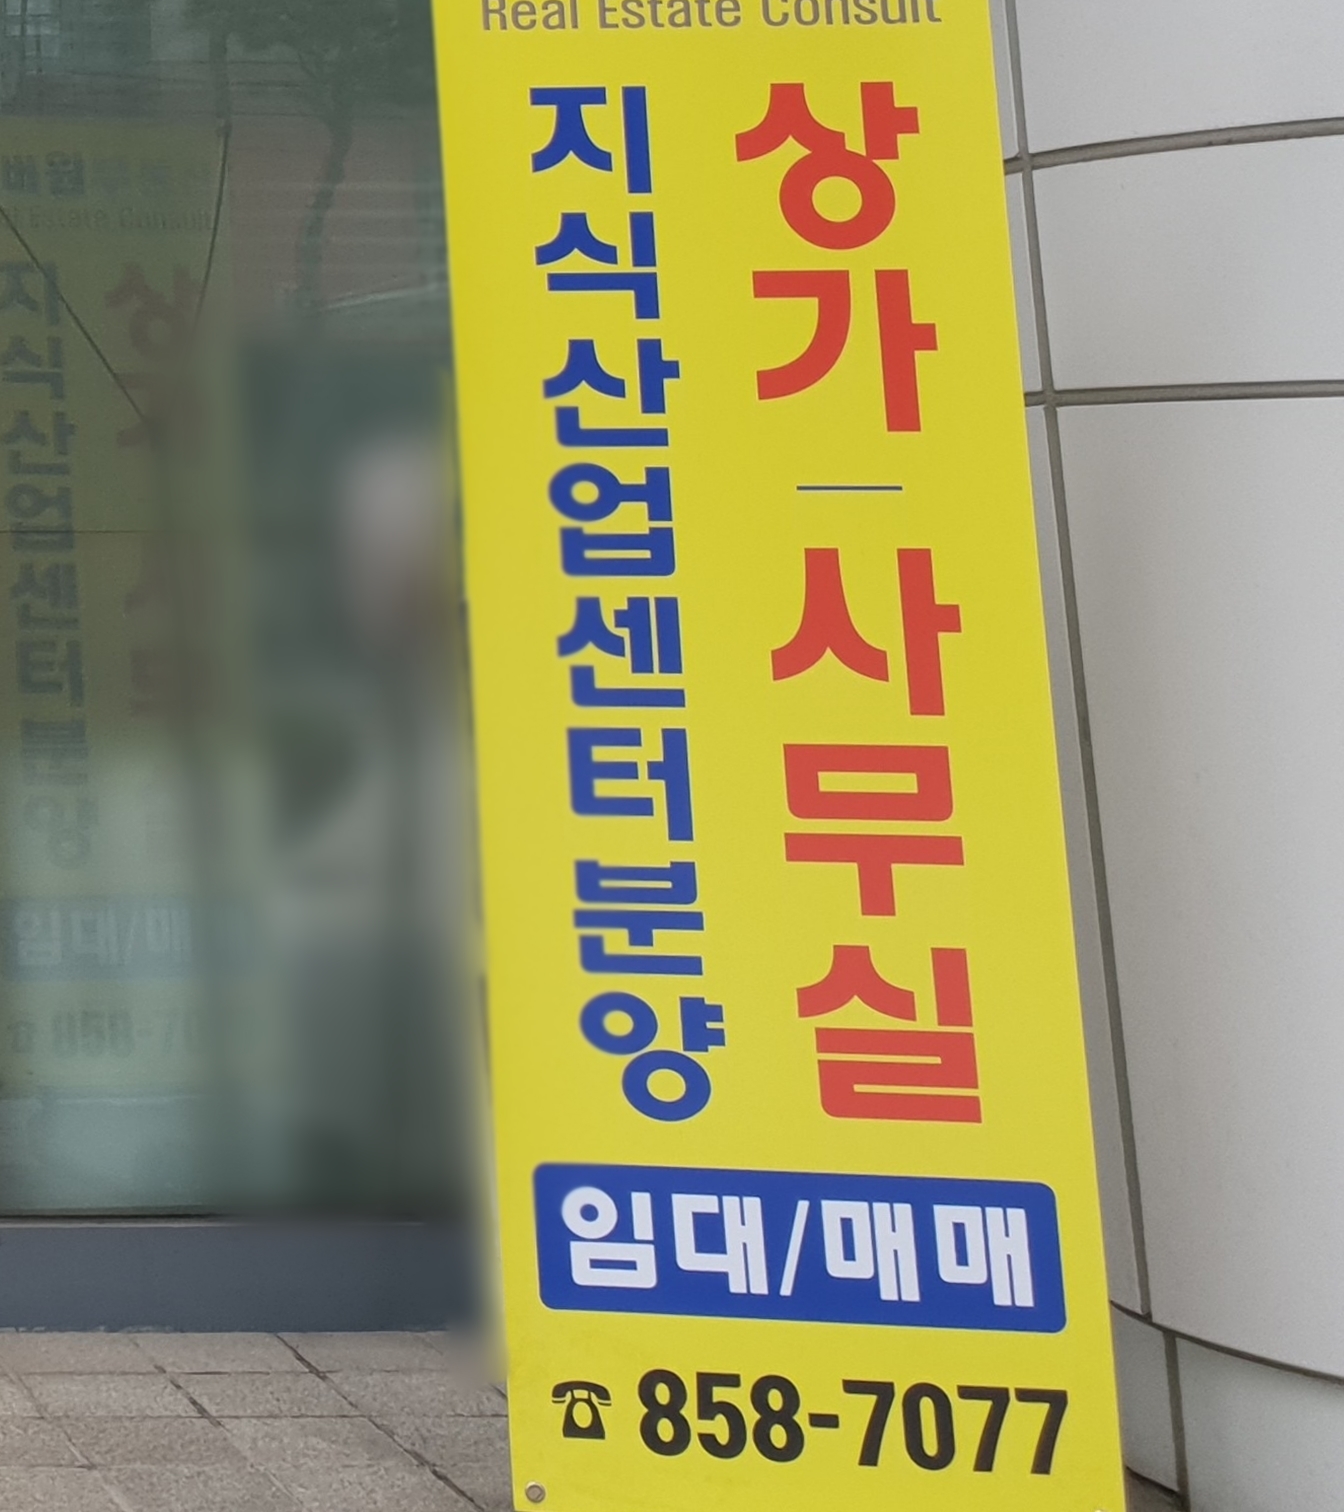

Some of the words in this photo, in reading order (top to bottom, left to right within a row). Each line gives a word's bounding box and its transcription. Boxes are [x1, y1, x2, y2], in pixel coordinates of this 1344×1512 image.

[735, 81, 939, 433] 상가
[769, 547, 983, 1124] 사무실
[560, 1185, 1034, 1308] 임대/매매
[636, 1368, 1068, 1475] 858-7077
